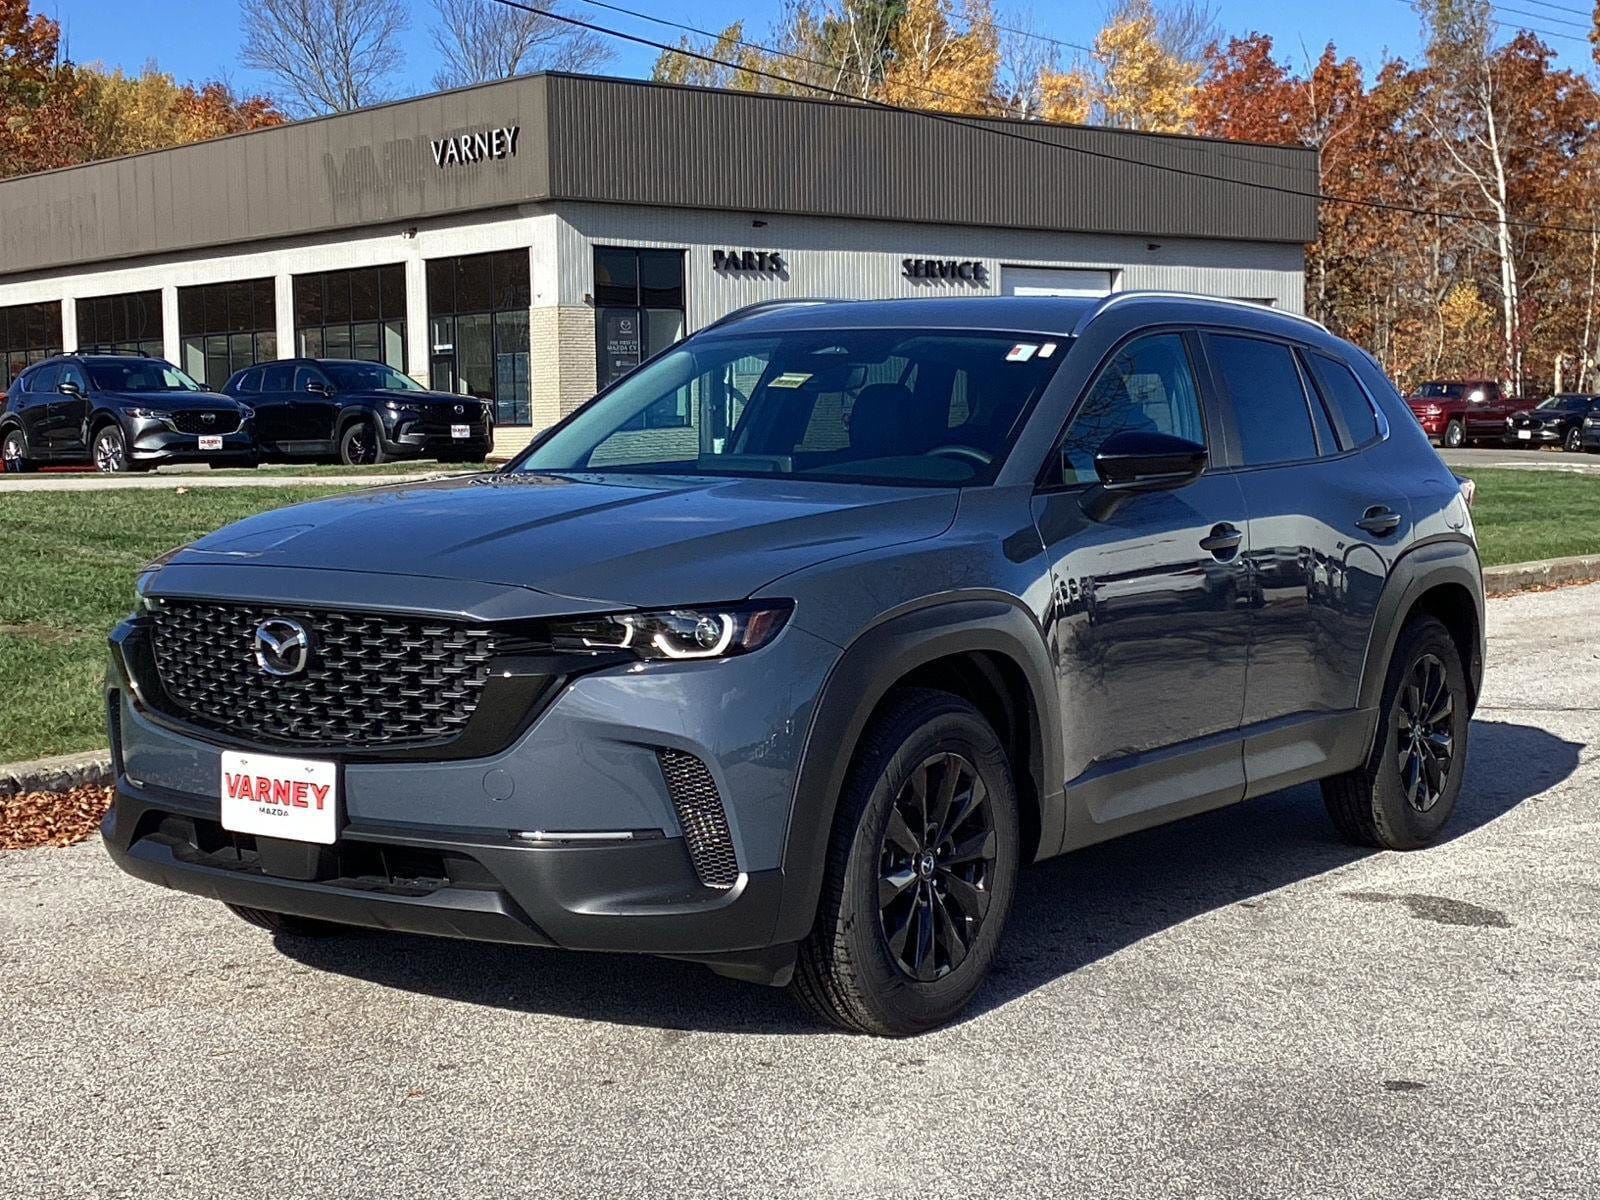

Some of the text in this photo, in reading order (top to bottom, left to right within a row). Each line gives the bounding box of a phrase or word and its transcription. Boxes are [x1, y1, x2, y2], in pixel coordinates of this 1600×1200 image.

[430, 126, 518, 168] VARNEY
[713, 250, 782, 273] PARTS
[902, 259, 985, 281] SERVICE
[225, 772, 330, 810] VARNEY
[259, 807, 289, 817] MAZDA
